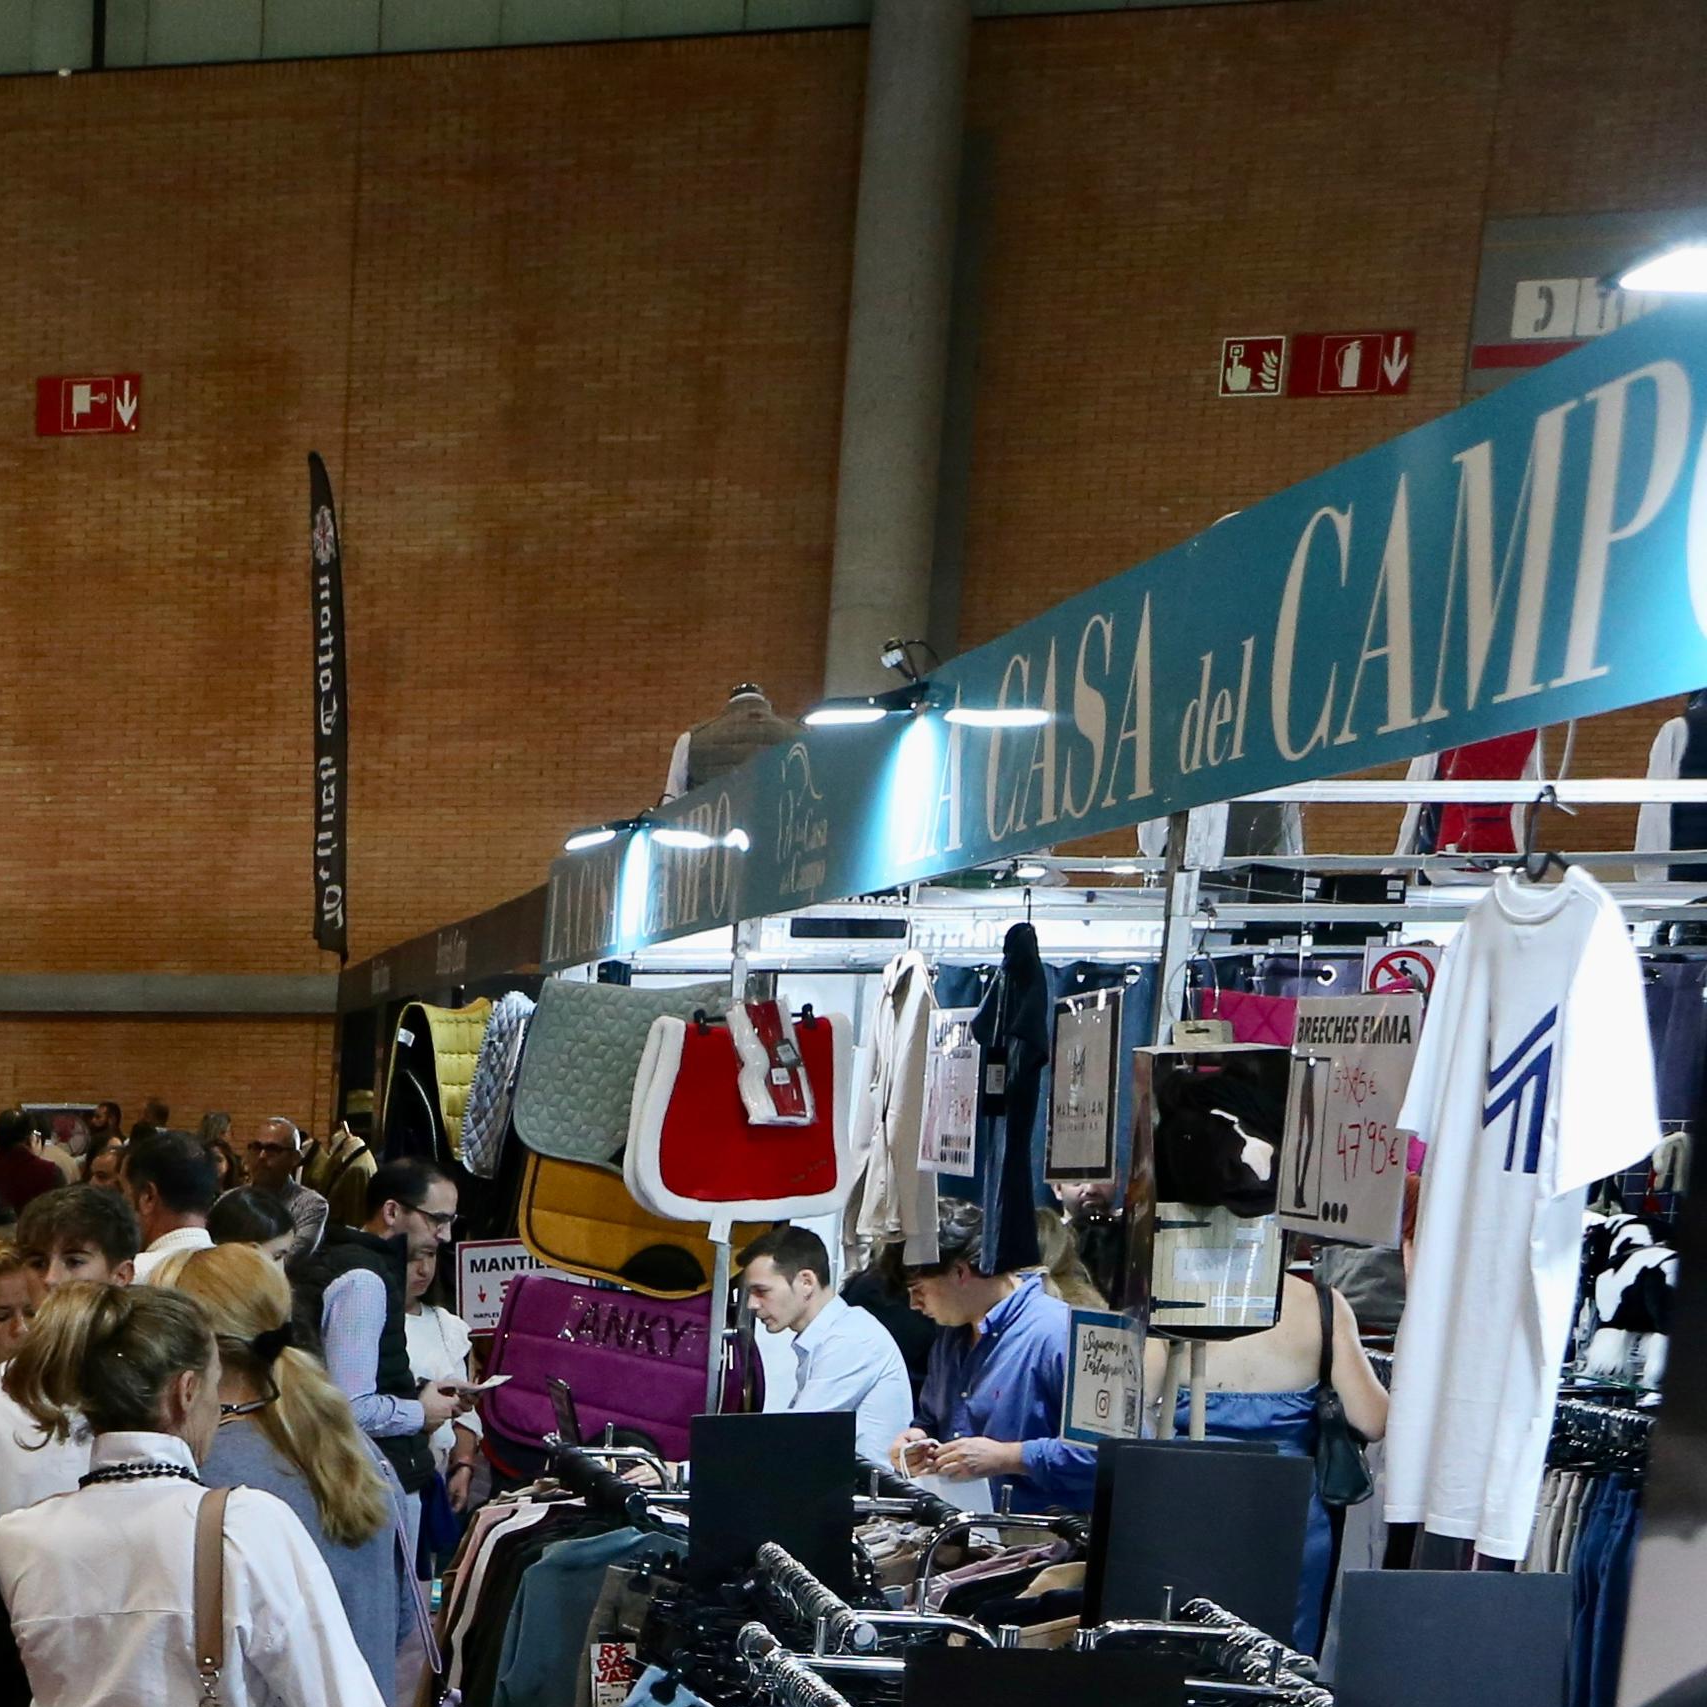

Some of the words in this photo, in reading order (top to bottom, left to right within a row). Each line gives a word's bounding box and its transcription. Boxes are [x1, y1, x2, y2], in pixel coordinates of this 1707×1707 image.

[987, 590, 1154, 843] CASA
[1179, 635, 1255, 775] del
[1271, 359, 1707, 763] CAMP
[1297, 1015, 1360, 1045] BREECHES
[1361, 1015, 1412, 1045] EMMA
[575, 1301, 693, 1358] ANKY
